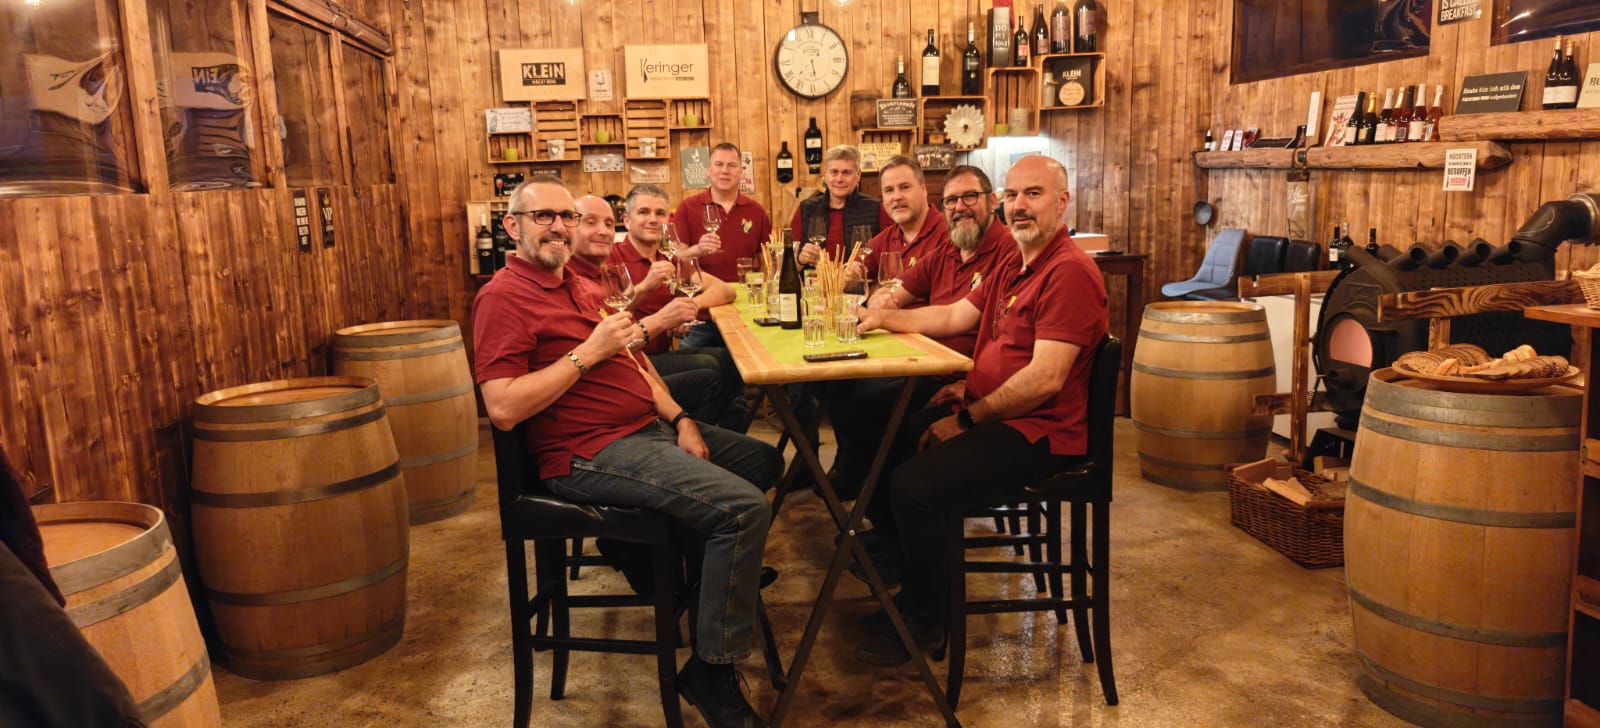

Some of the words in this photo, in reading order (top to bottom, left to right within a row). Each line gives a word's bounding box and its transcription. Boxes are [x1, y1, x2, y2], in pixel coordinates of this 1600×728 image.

[522, 64, 564, 78] KLEIN
[640, 57, 694, 81] Keringer
[1062, 70, 1081, 78] KLEIN
